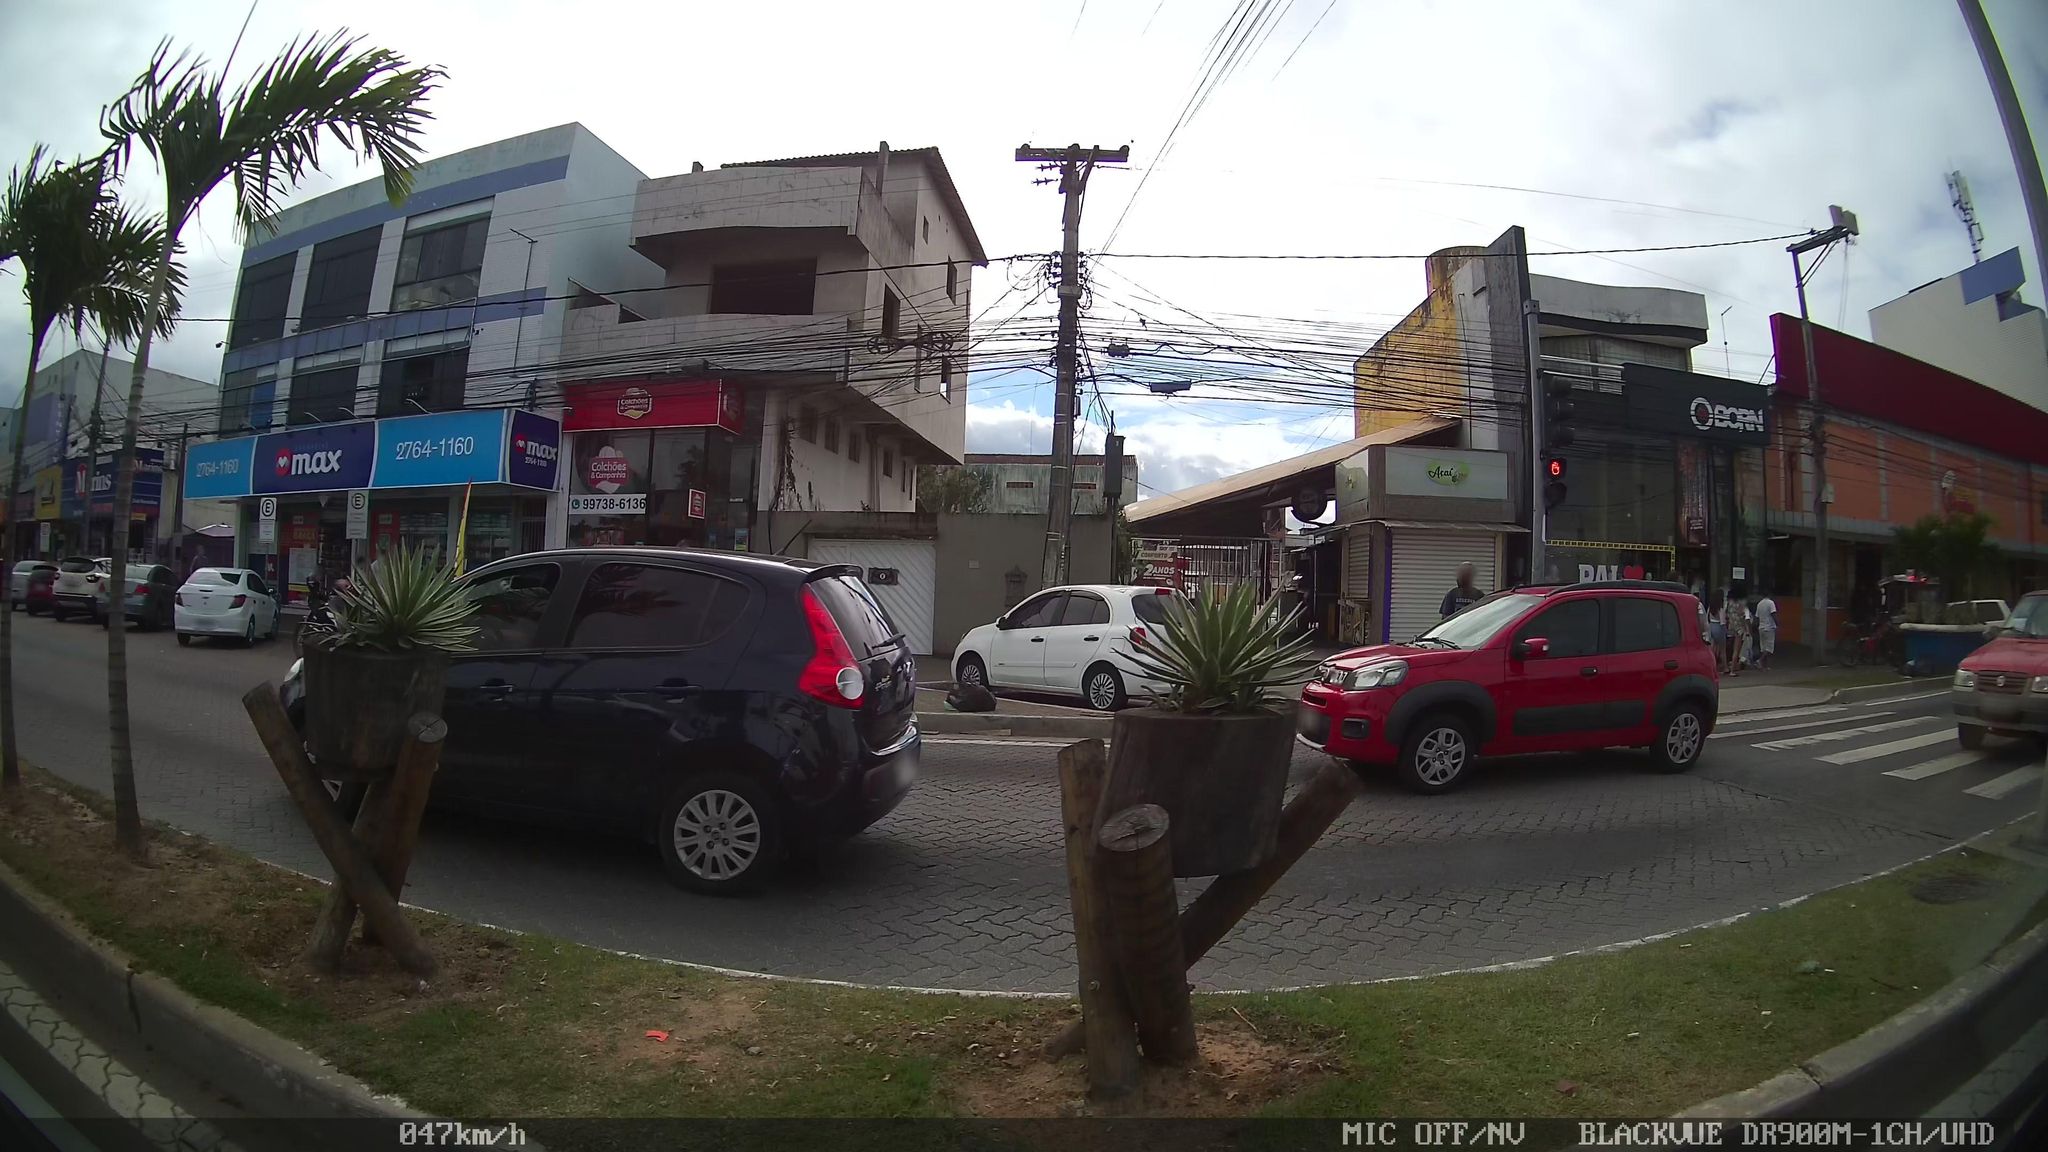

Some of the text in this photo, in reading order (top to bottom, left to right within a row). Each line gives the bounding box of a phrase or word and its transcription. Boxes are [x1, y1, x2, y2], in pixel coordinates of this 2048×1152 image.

[395, 436, 474, 460] 2764-1160
[526, 440, 558, 460] max
[196, 458, 239, 477] 2764-1160
[291, 449, 343, 476] max
[591, 461, 627, 472] Colchões
[582, 499, 646, 510] 99738-6136
